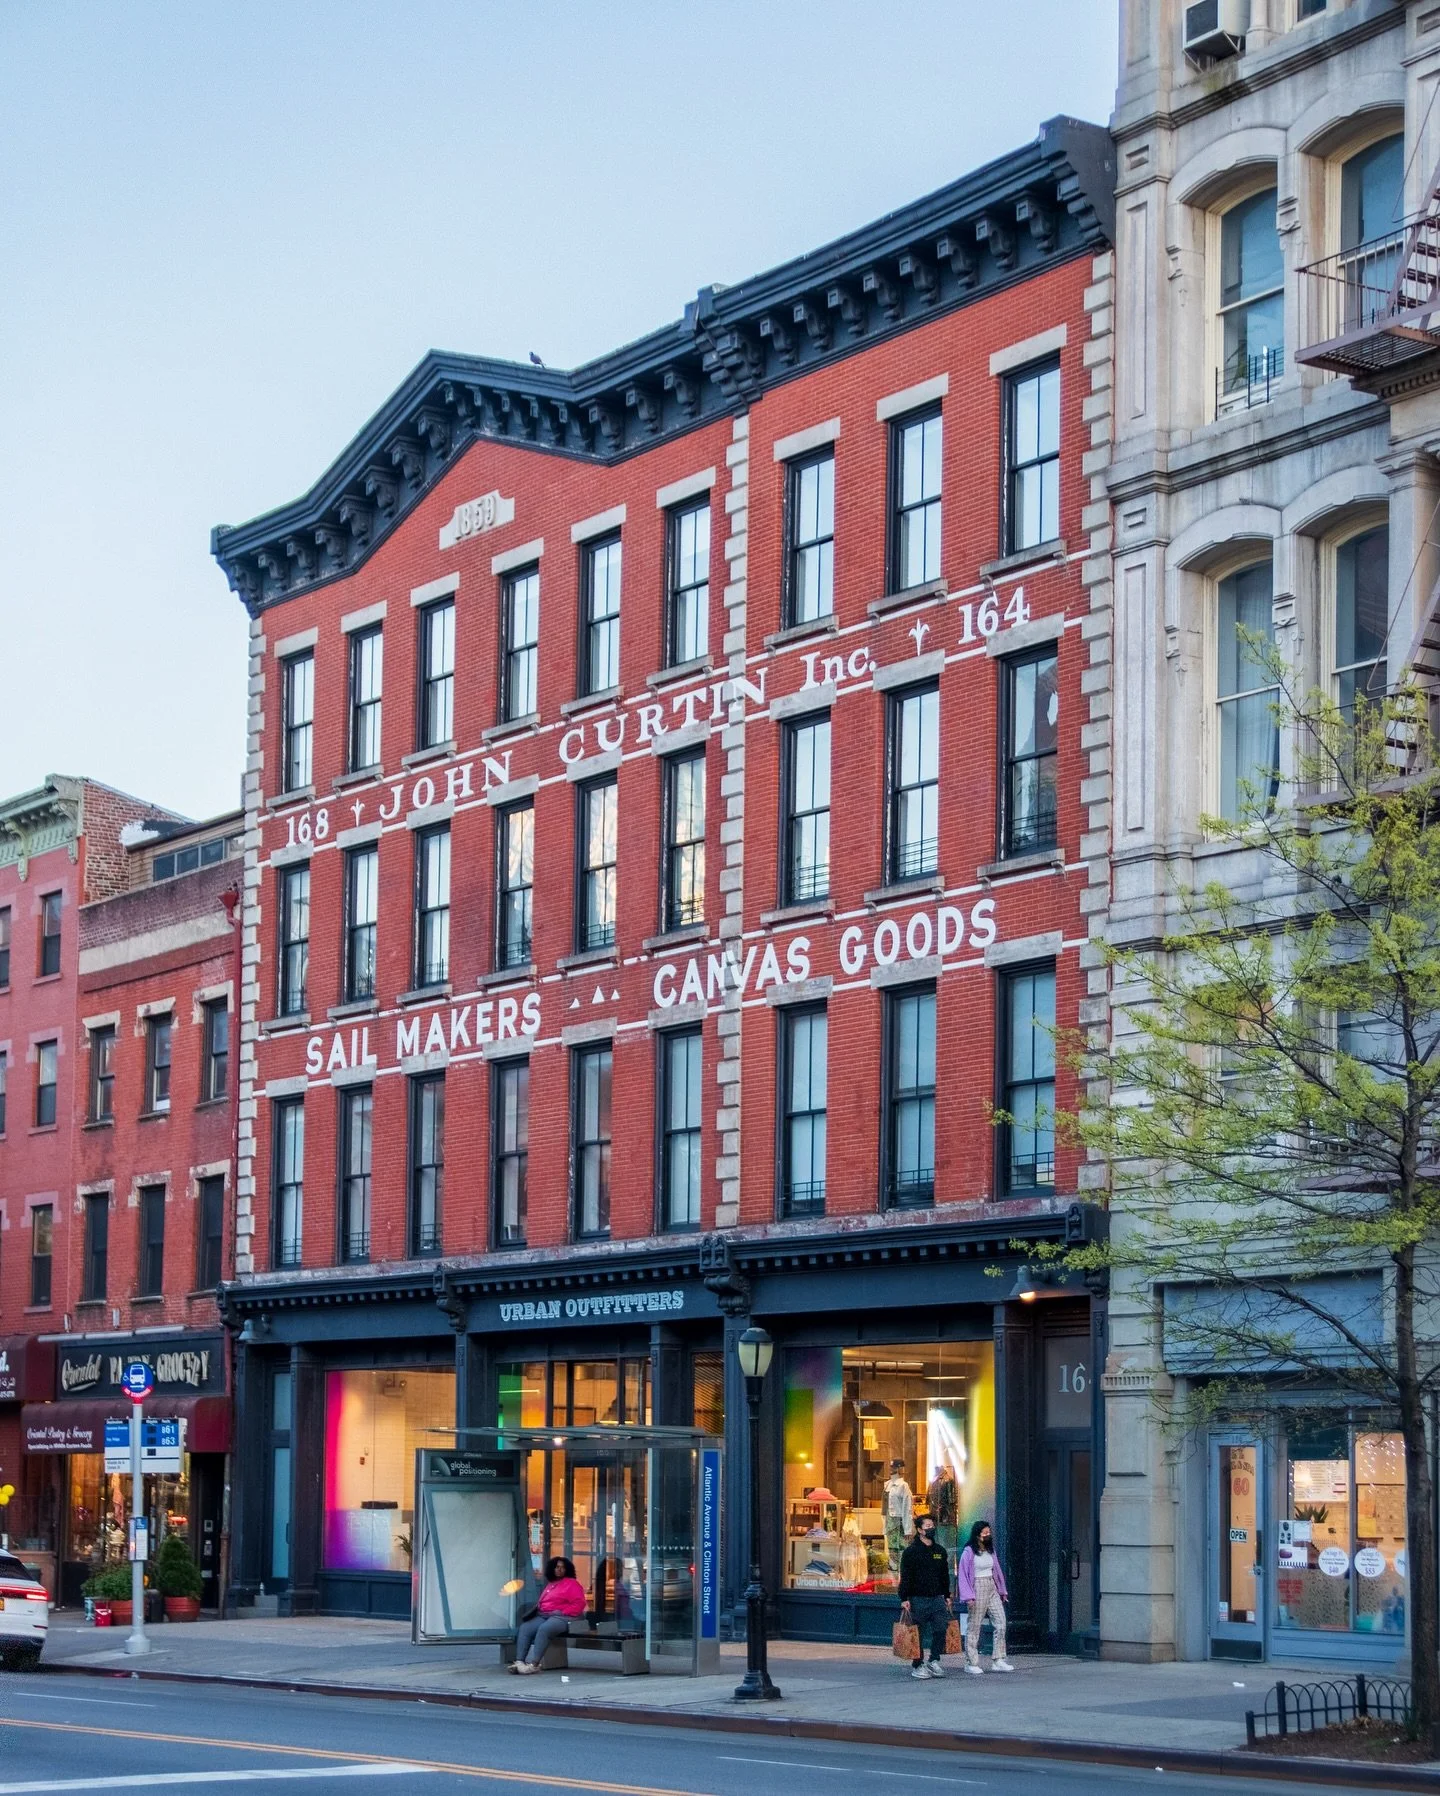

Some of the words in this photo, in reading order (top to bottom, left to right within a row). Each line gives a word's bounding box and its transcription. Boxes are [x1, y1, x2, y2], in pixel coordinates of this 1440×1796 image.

[454, 495, 496, 541] 1859
[285, 809, 329, 848] 168
[380, 750, 513, 820] JOHN
[559, 667, 768, 764] CURTIN
[799, 646, 878, 692] Inc.
[959, 586, 1030, 645] 164
[305, 1027, 377, 1075] SAIL
[396, 993, 541, 1060] MAKERS
[654, 936, 811, 1008] CANVAS
[840, 899, 996, 975] GOODS
[500, 1302, 561, 1321] URBAN
[565, 1291, 684, 1317] OUTFITTERS
[1059, 1362, 1091, 1393] 16
[161, 1425, 175, 1434] B61
[161, 1437, 175, 1445] B63
[450, 1461, 471, 1470] global
[459, 1468, 496, 1476] positioning
[704, 1466, 712, 1502] Atlantic
[704, 1504, 712, 1539] Avenue
[1230, 1530, 1247, 1540] OPEN
[704, 1540, 711, 1548] &
[703, 1550, 711, 1584] Clinton
[796, 1577, 818, 1587] Urban
[703, 1586, 711, 1614] Street
